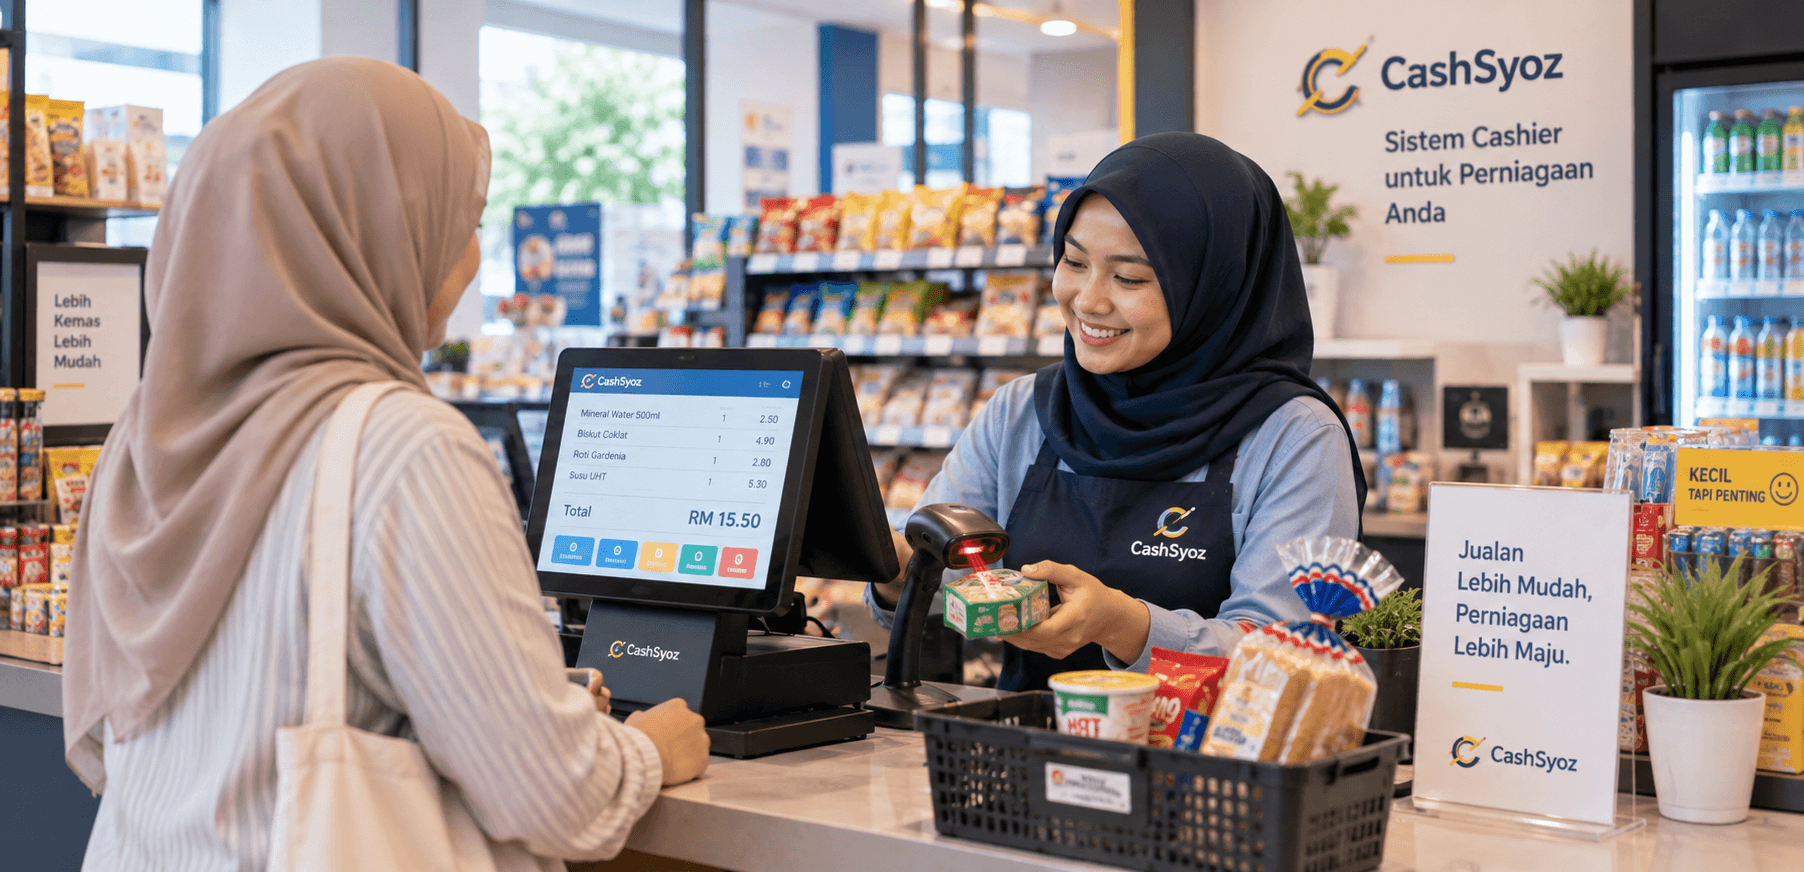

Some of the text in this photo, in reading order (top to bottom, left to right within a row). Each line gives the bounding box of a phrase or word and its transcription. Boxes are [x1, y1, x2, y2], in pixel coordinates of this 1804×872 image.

[1381, 49, 1563, 92] CashSyoz
[1386, 122, 1562, 152] Sistem Cashier
[1386, 160, 1593, 188] untuk Perniagaan
[1385, 201, 1445, 224] Anda
[55, 294, 91, 308] Lebih
[55, 314, 100, 327] Kemas
[54, 335, 91, 348] Lebih
[54, 355, 101, 368] Mudah
[597, 375, 642, 389] CashSyoz
[581, 410, 609, 418] Mineral
[636, 411, 660, 419] 500ml
[760, 415, 778, 423] 2.50
[577, 429, 601, 438] Biskut
[603, 430, 627, 439] Coklat
[756, 437, 774, 445] 4.90
[573, 450, 589, 458] Roti
[591, 451, 626, 460] Gardenia
[752, 458, 771, 467] 2.80
[569, 471, 587, 480] Susu
[590, 472, 607, 480] UHT
[748, 479, 767, 489] 5.30
[1690, 467, 1731, 483] KECIL
[1688, 488, 1765, 503] TAPI PENTING
[564, 505, 761, 528] Total RM 15.50
[1131, 540, 1206, 561] CashSyoz
[1459, 540, 1523, 562] Jualan
[1458, 571, 1592, 602] Lebih Mudah,
[1455, 603, 1568, 633] Perniagaan
[627, 644, 680, 661] CashSyoz
[1455, 636, 1569, 668] Lebih Maju.
[1491, 746, 1577, 773] CashSyoz
